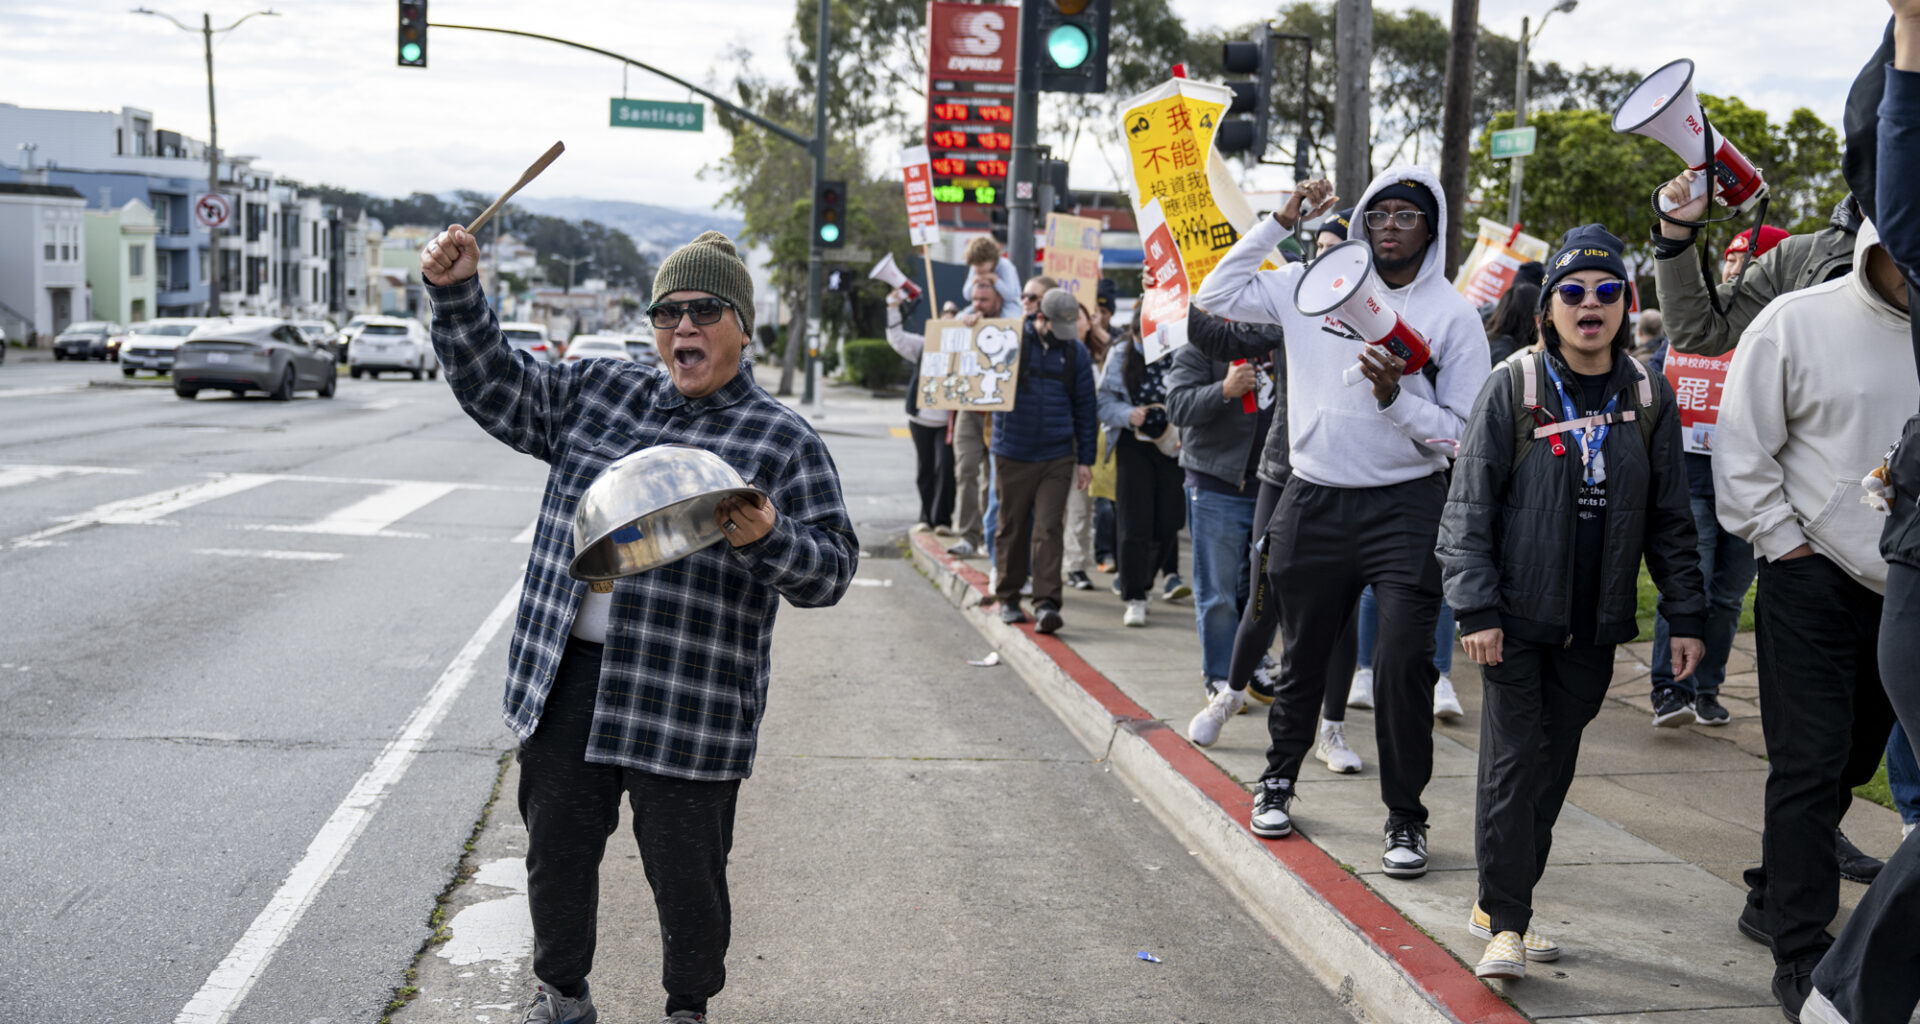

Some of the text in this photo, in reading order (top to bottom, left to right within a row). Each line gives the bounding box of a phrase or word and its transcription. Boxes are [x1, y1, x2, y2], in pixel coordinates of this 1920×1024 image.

[948, 56, 1003, 71] EXPRESS
[619, 105, 695, 127] Santiago
[1166, 104, 1192, 135] 我
[1685, 115, 1702, 134] PYLE
[1141, 139, 1197, 174] 不能
[1150, 240, 1163, 260] ON
[1584, 249, 1609, 258] UESF
[1156, 257, 1178, 288] STRIKE
[1366, 296, 1381, 314] PYLE
[1590, 487, 1605, 495] the
